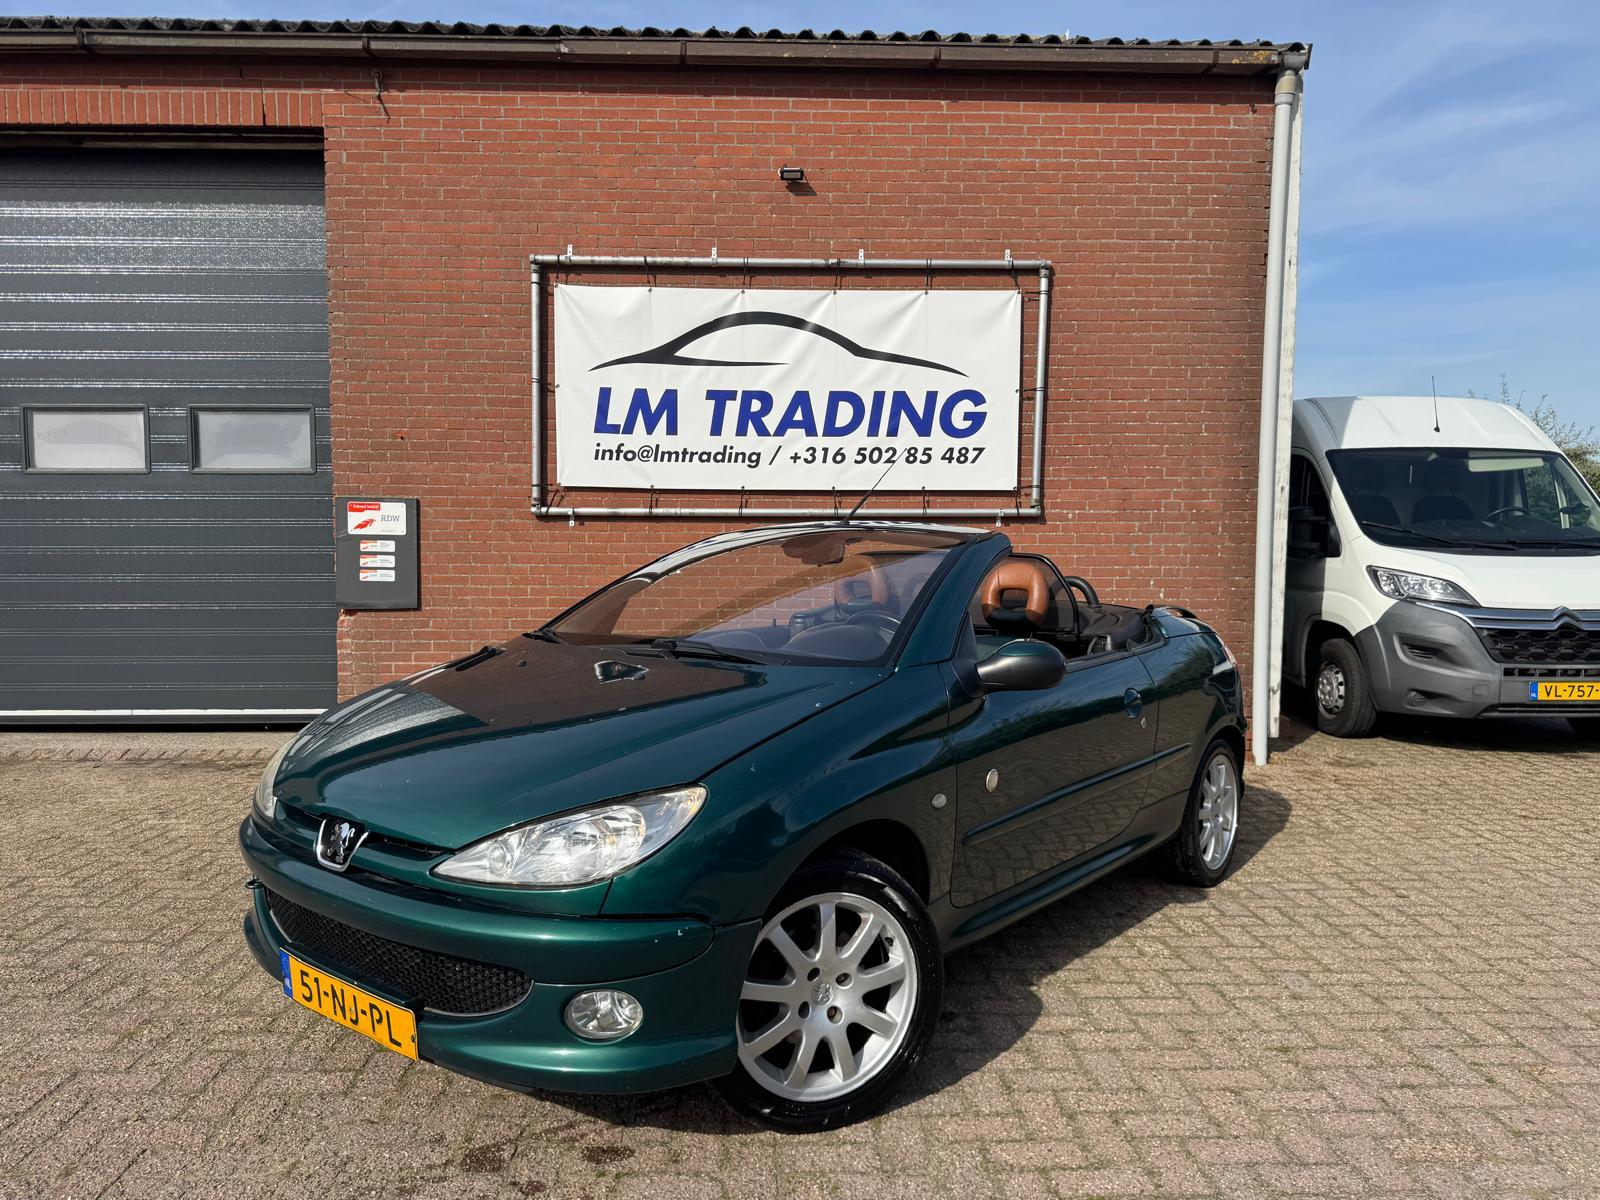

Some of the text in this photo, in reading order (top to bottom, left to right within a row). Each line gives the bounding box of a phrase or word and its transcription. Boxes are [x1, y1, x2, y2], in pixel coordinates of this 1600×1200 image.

[593, 386, 988, 439] LM TRADING
[593, 442, 986, 469] info@lmtrading / +316 502 85 487
[380, 514, 400, 522] RDW
[300, 969, 402, 1048] 51-NJ-PL
